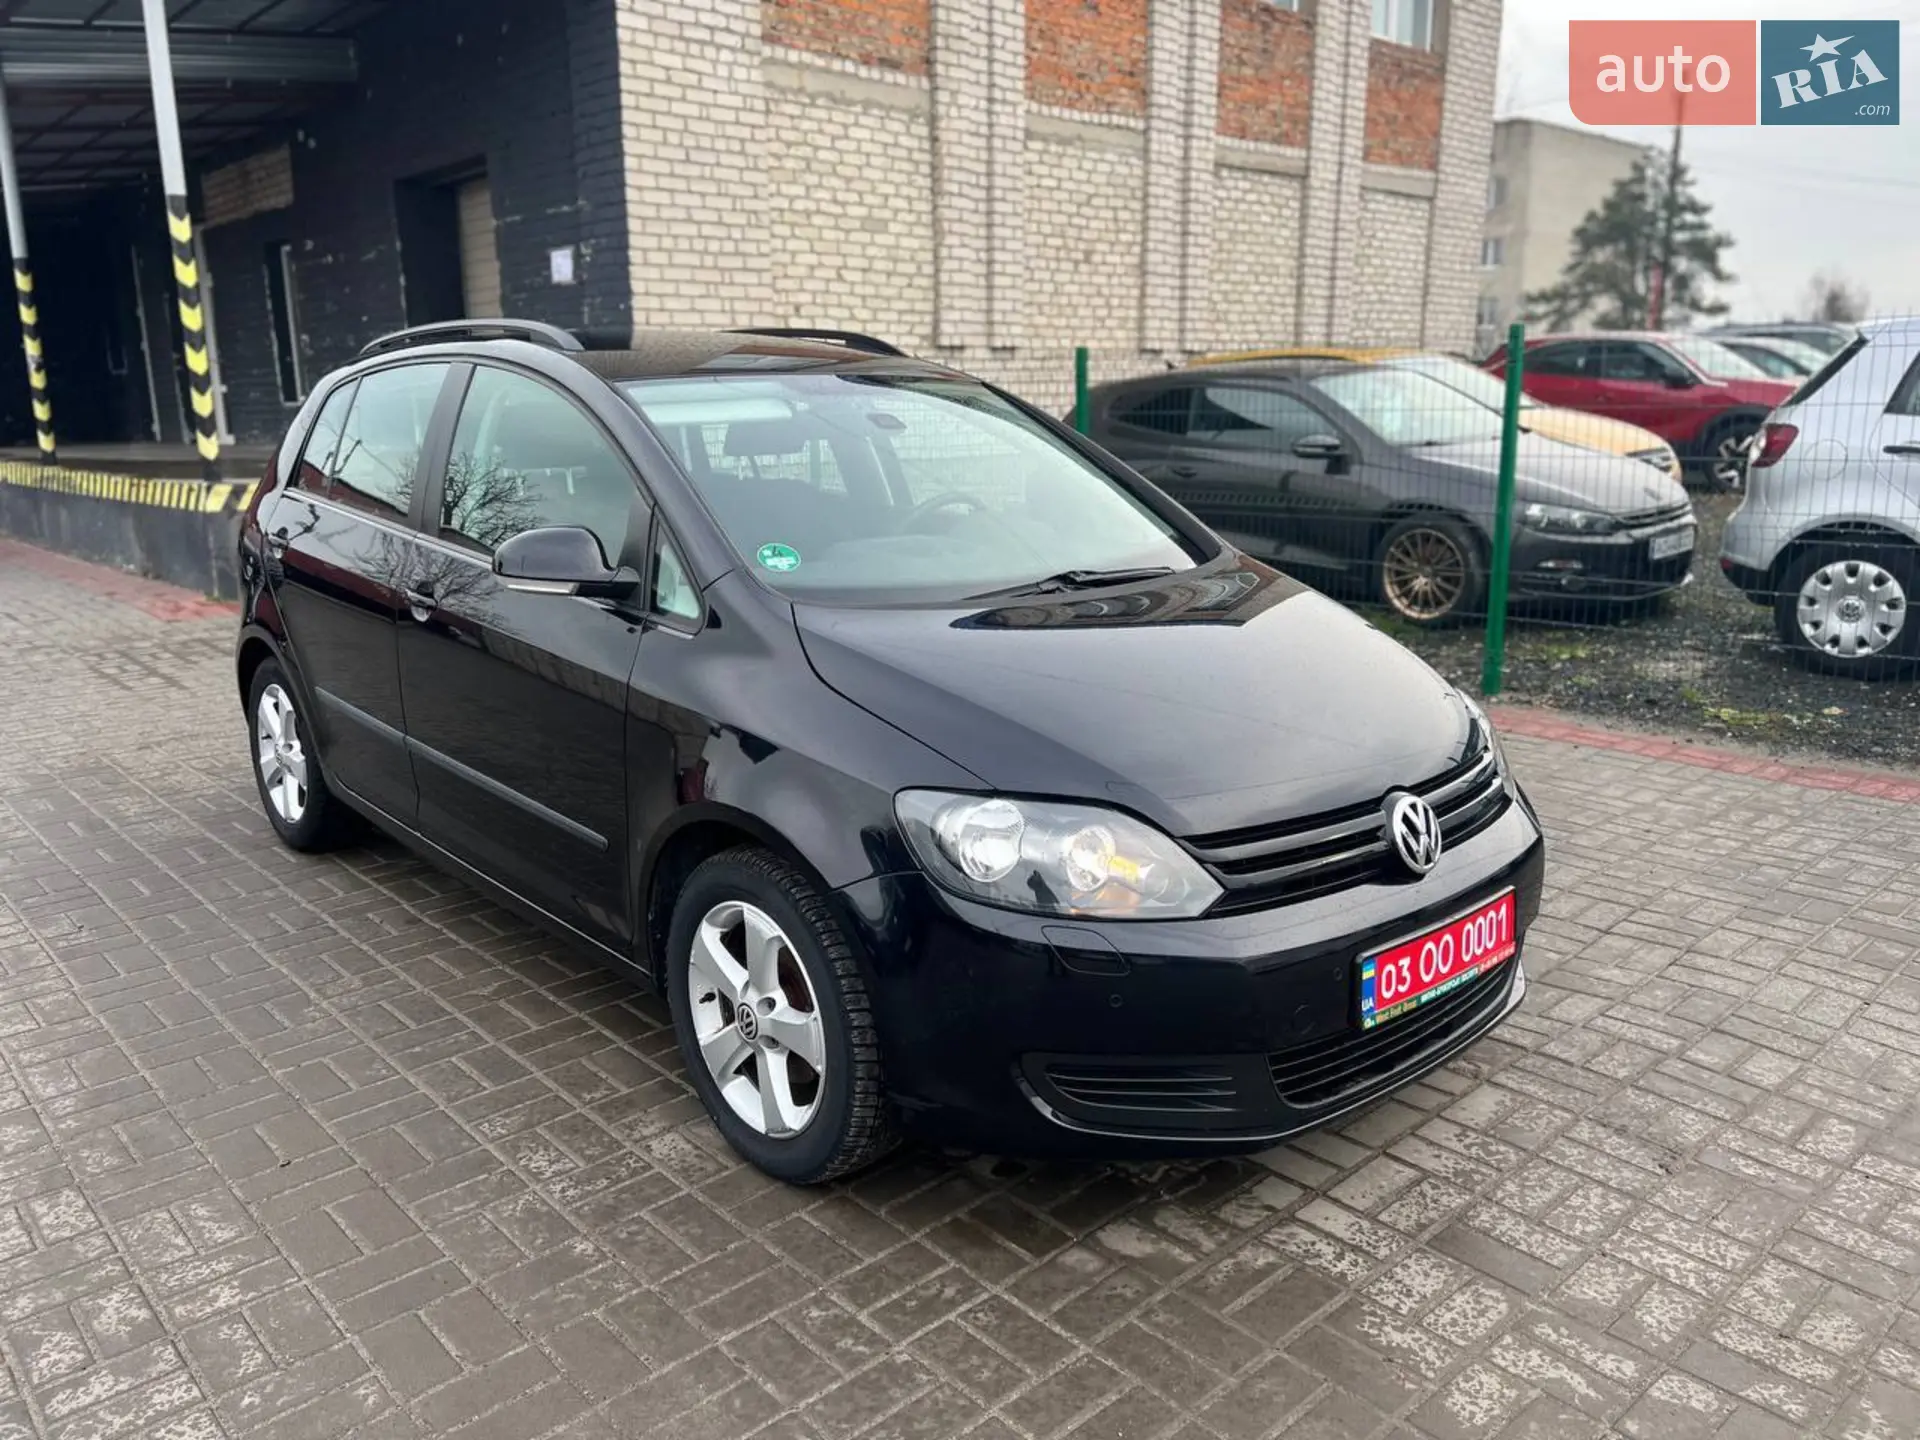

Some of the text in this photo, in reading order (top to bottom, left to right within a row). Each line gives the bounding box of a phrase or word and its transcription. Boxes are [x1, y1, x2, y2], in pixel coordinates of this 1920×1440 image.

[1381, 956, 1412, 999] 03
[1461, 902, 1507, 962] 0001
[1361, 996, 1374, 1011] UA
